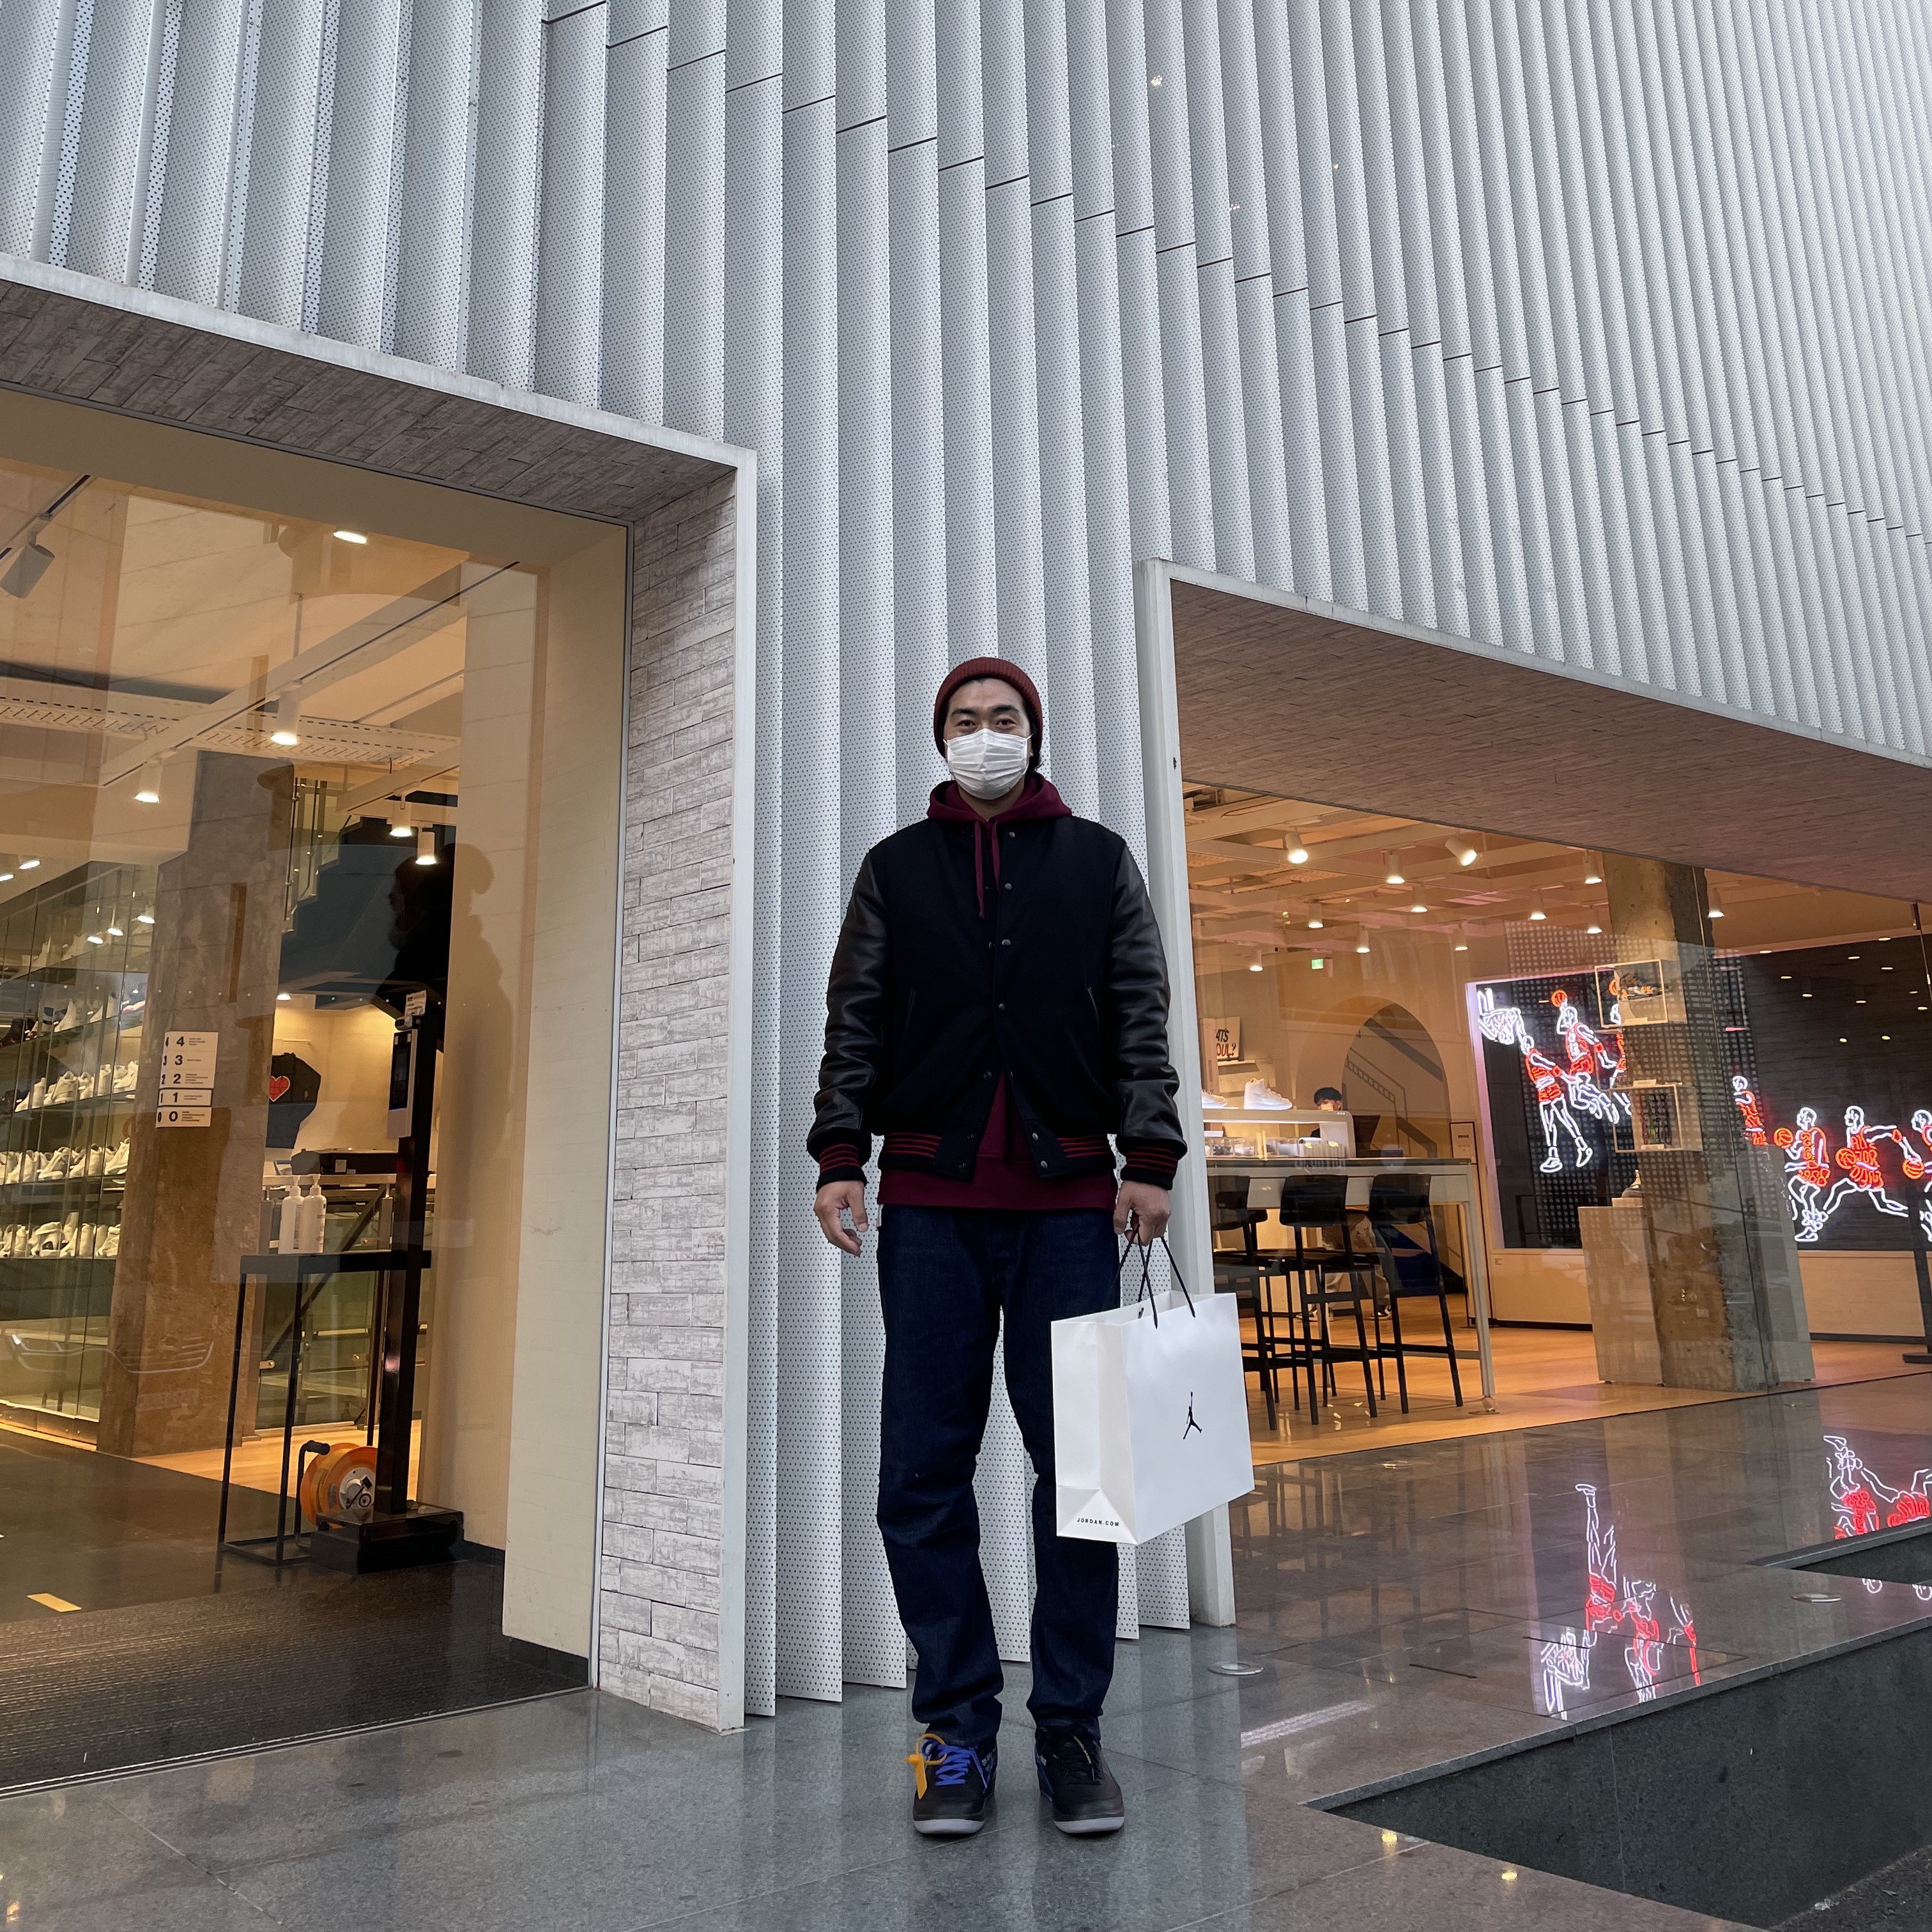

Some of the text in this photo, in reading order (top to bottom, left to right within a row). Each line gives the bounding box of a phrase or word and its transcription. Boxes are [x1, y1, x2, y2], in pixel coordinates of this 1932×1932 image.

[176, 1036, 185, 1046] 4
[174, 1055, 183, 1065] 3
[173, 1073, 181, 1084] 2
[172, 1092, 178, 1103] 1
[169, 1111, 178, 1122] 0
[1077, 1517, 1119, 1526] JORDAN.COM
